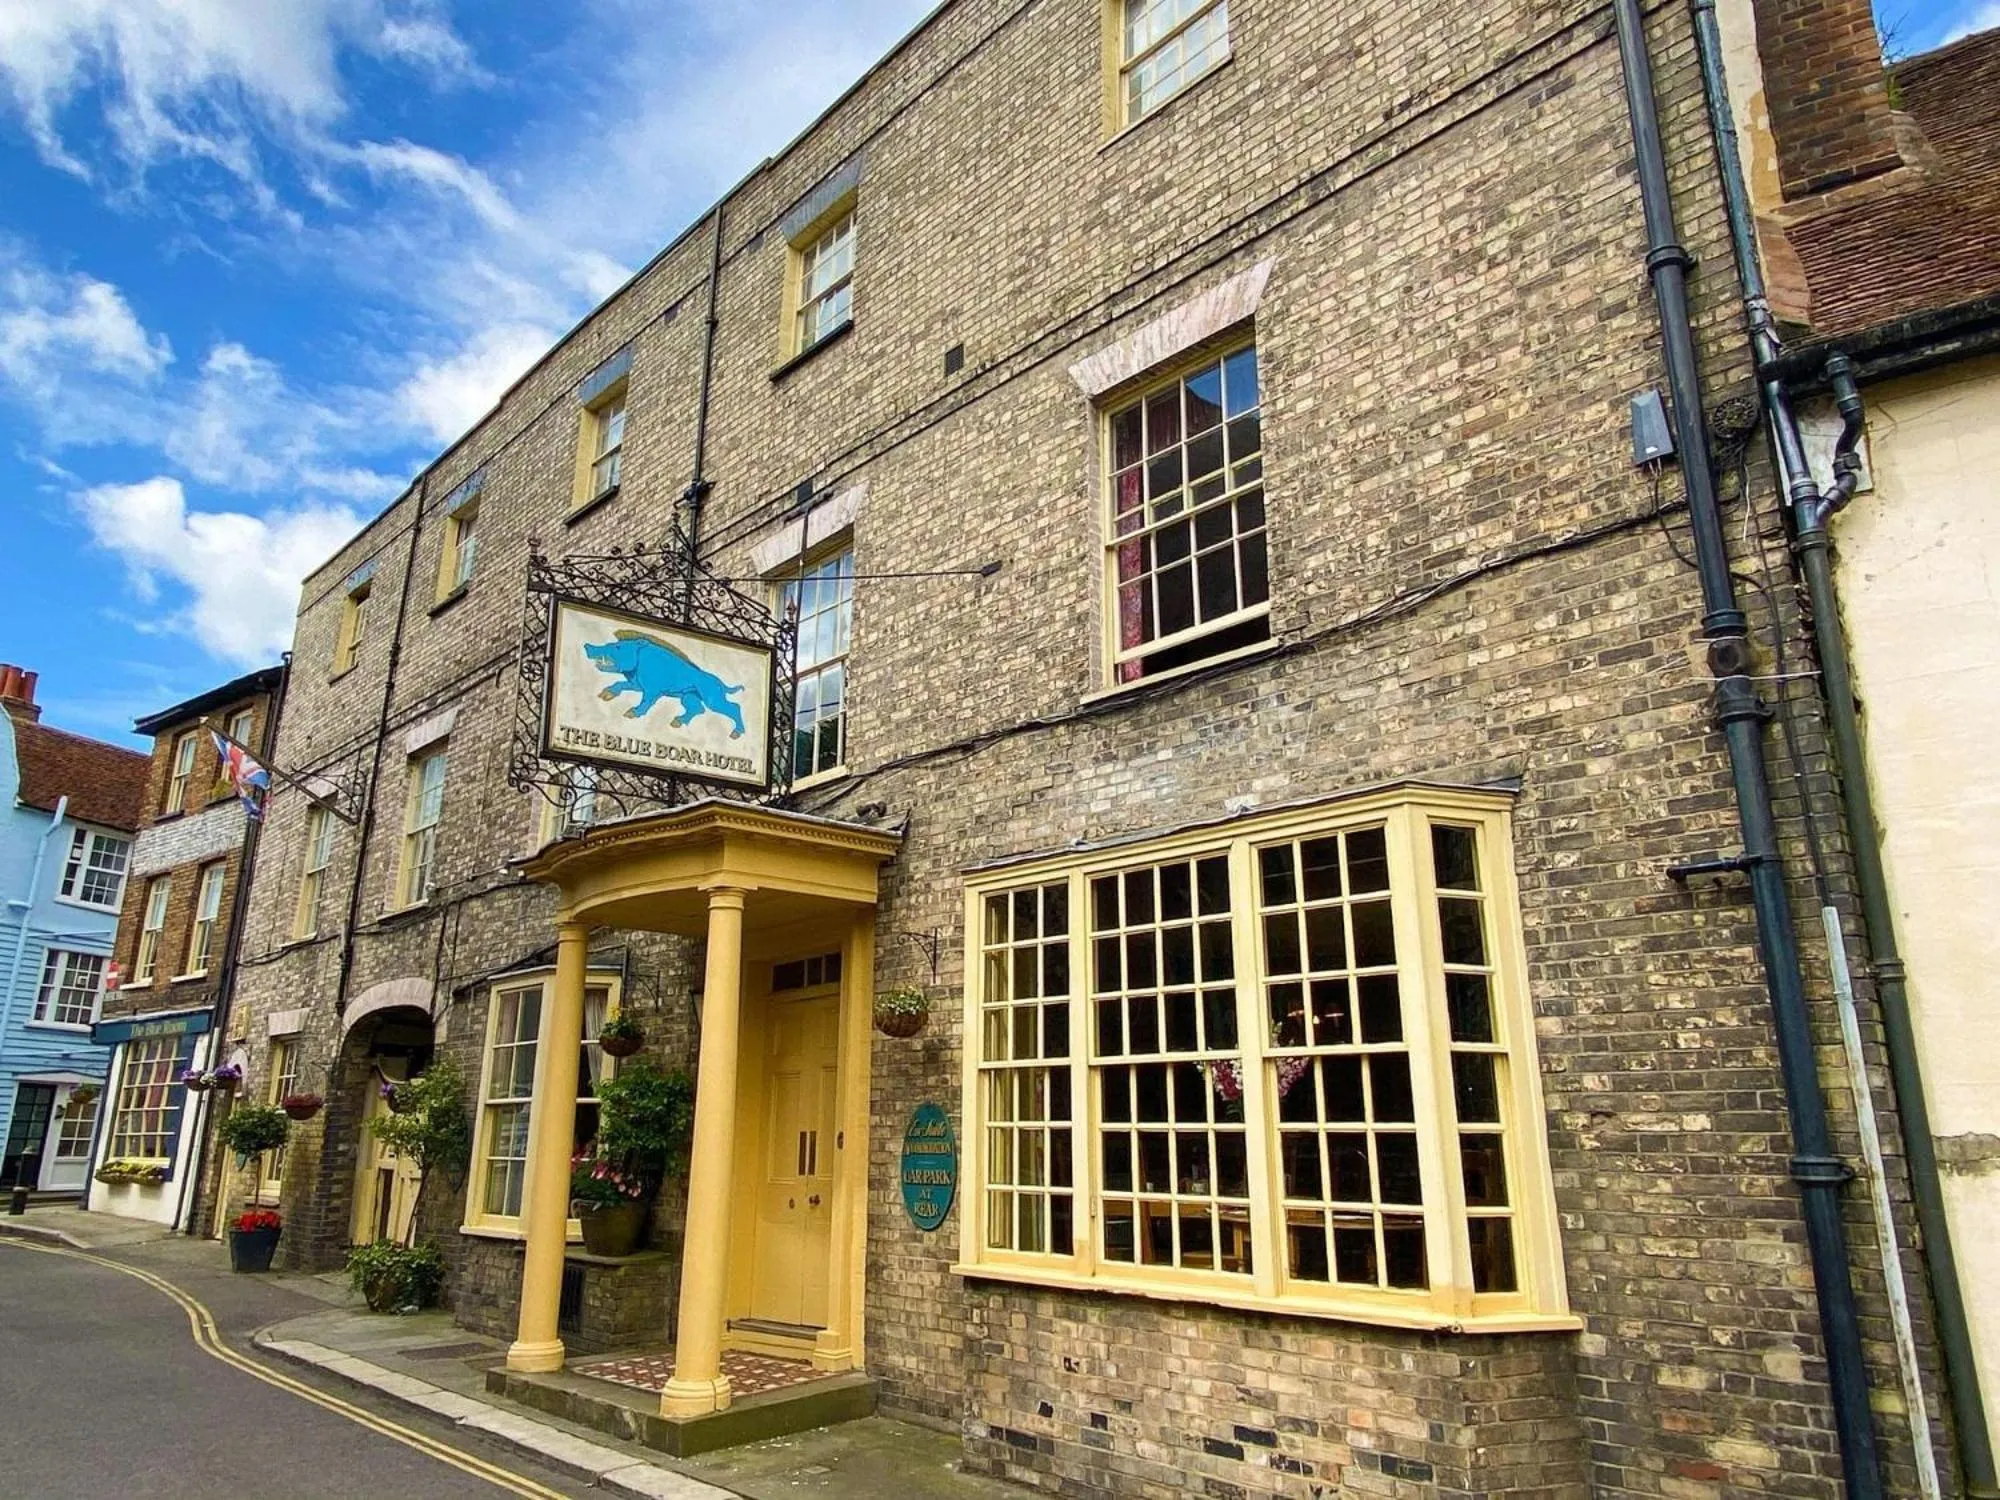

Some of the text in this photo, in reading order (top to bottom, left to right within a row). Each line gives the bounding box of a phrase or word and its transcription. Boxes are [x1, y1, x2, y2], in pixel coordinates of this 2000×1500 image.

[560, 725, 756, 774] THE BLUE BOAR HOTEL
[903, 1169, 951, 1184] CAR PARK
[920, 1188, 932, 1199] AT
[914, 1201, 939, 1216] REAR
